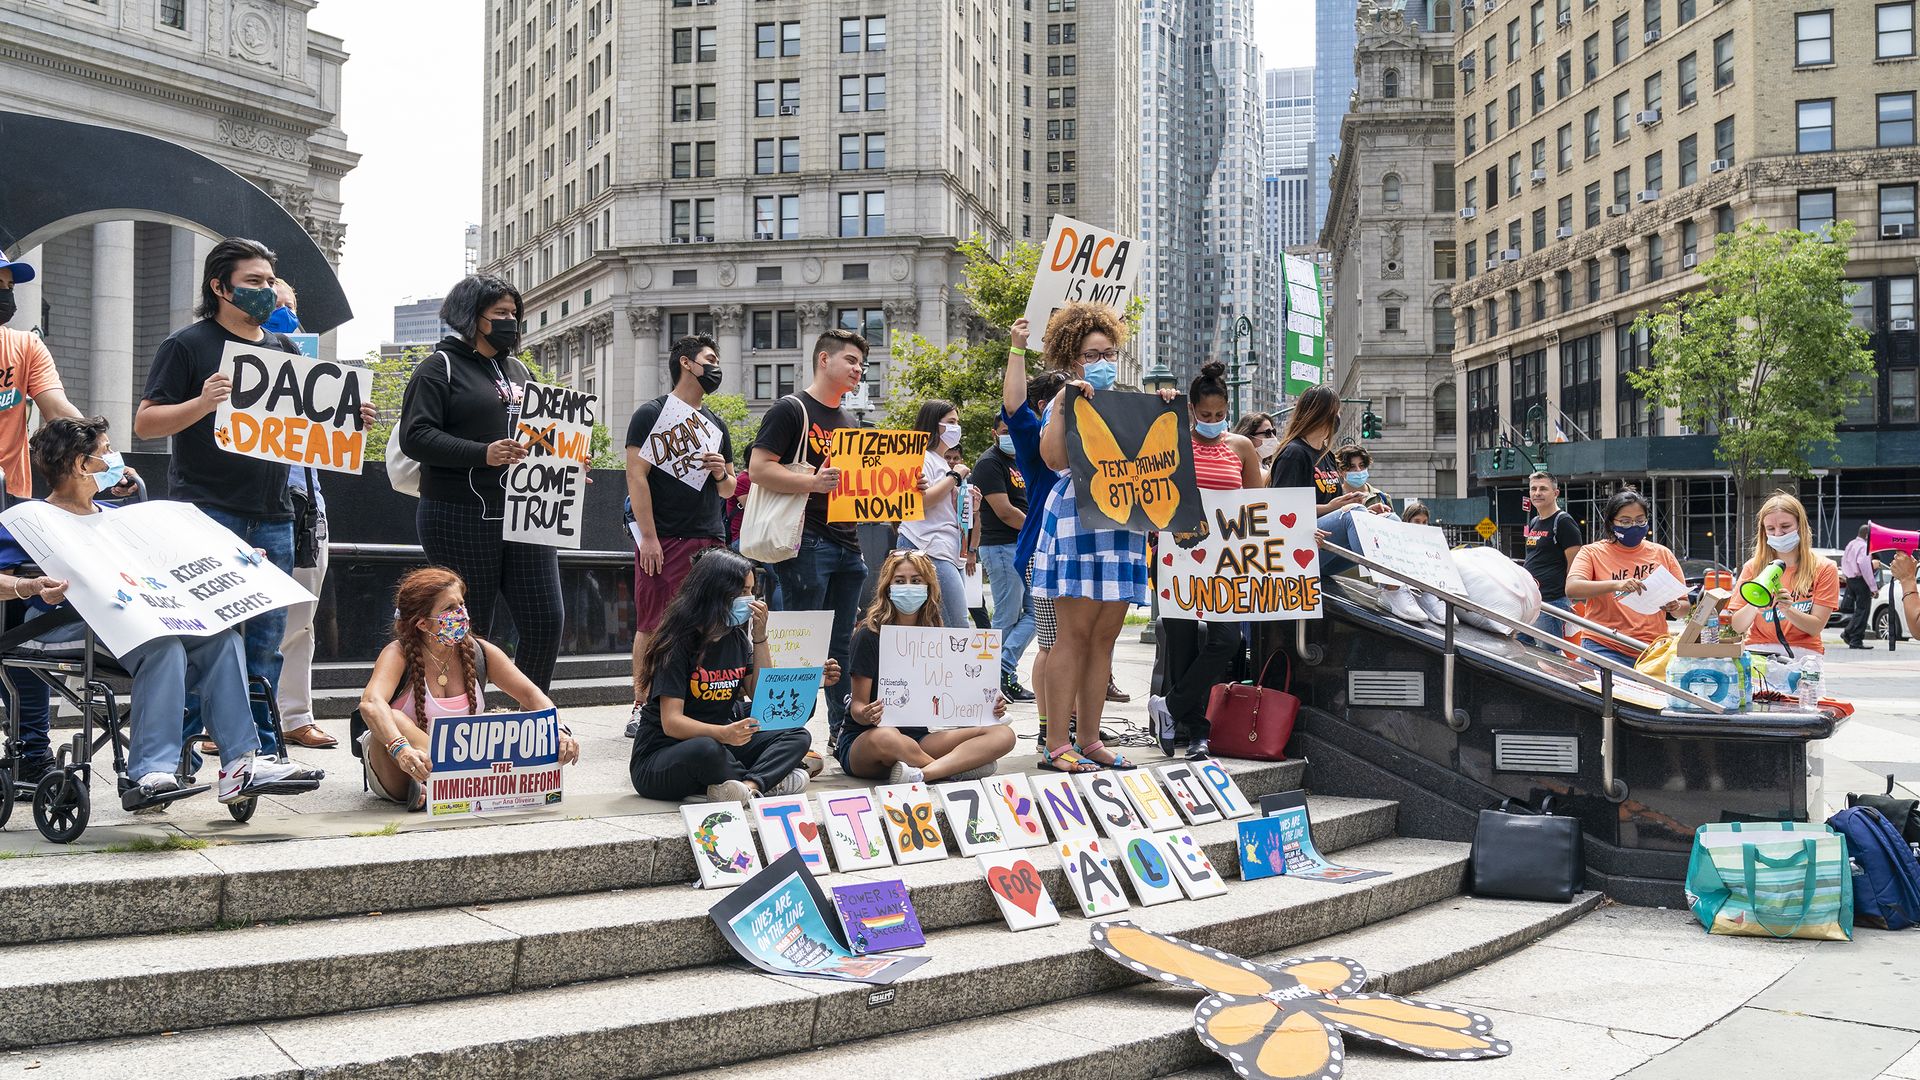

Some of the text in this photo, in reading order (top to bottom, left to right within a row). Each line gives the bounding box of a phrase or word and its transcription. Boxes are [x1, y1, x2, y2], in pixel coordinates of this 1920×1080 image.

[1050, 227, 1131, 281] DACA
[1064, 277, 1126, 308] IS NOT
[230, 354, 364, 431] DACA
[522, 382, 597, 427] DREAMS
[230, 411, 363, 471] DREAM
[557, 430, 590, 463] WILL
[831, 431, 929, 457] CITIZENSHIP
[862, 455, 882, 468] FOR
[1098, 450, 1177, 478] TEXT PATHWAY
[511, 463, 580, 497] COME
[505, 495, 575, 538] TRUE
[855, 492, 915, 520] NOW!!
[1215, 502, 1270, 541] WE
[169, 556, 223, 584] RIGHTS
[1214, 538, 1285, 577] ARE
[1612, 563, 1655, 580] WE ARE
[140, 571, 246, 609] BLACK RIGHTS
[1172, 573, 1321, 615] UNDENIABLE
[158, 592, 273, 631] HUMAN RIGHTS
[896, 630, 943, 667] United
[708, 680, 740, 690] STUDENT
[765, 673, 817, 683] CHINGA LA MIGRA
[925, 662, 953, 688] We
[942, 692, 984, 724] Dream
[437, 717, 556, 763] I SUPPORT
[491, 761, 512, 774] THE
[433, 775, 518, 801] IMMIGRATION
[519, 768, 561, 793] REFORM
[840, 889, 900, 907] POWER IS
[1000, 867, 1041, 900] FOR
[752, 890, 793, 937] LIVES ARE
[757, 901, 805, 952] ON THE LINE
[849, 907, 870, 919] THE
[855, 921, 866, 931] TO
[788, 925, 802, 941] THE
